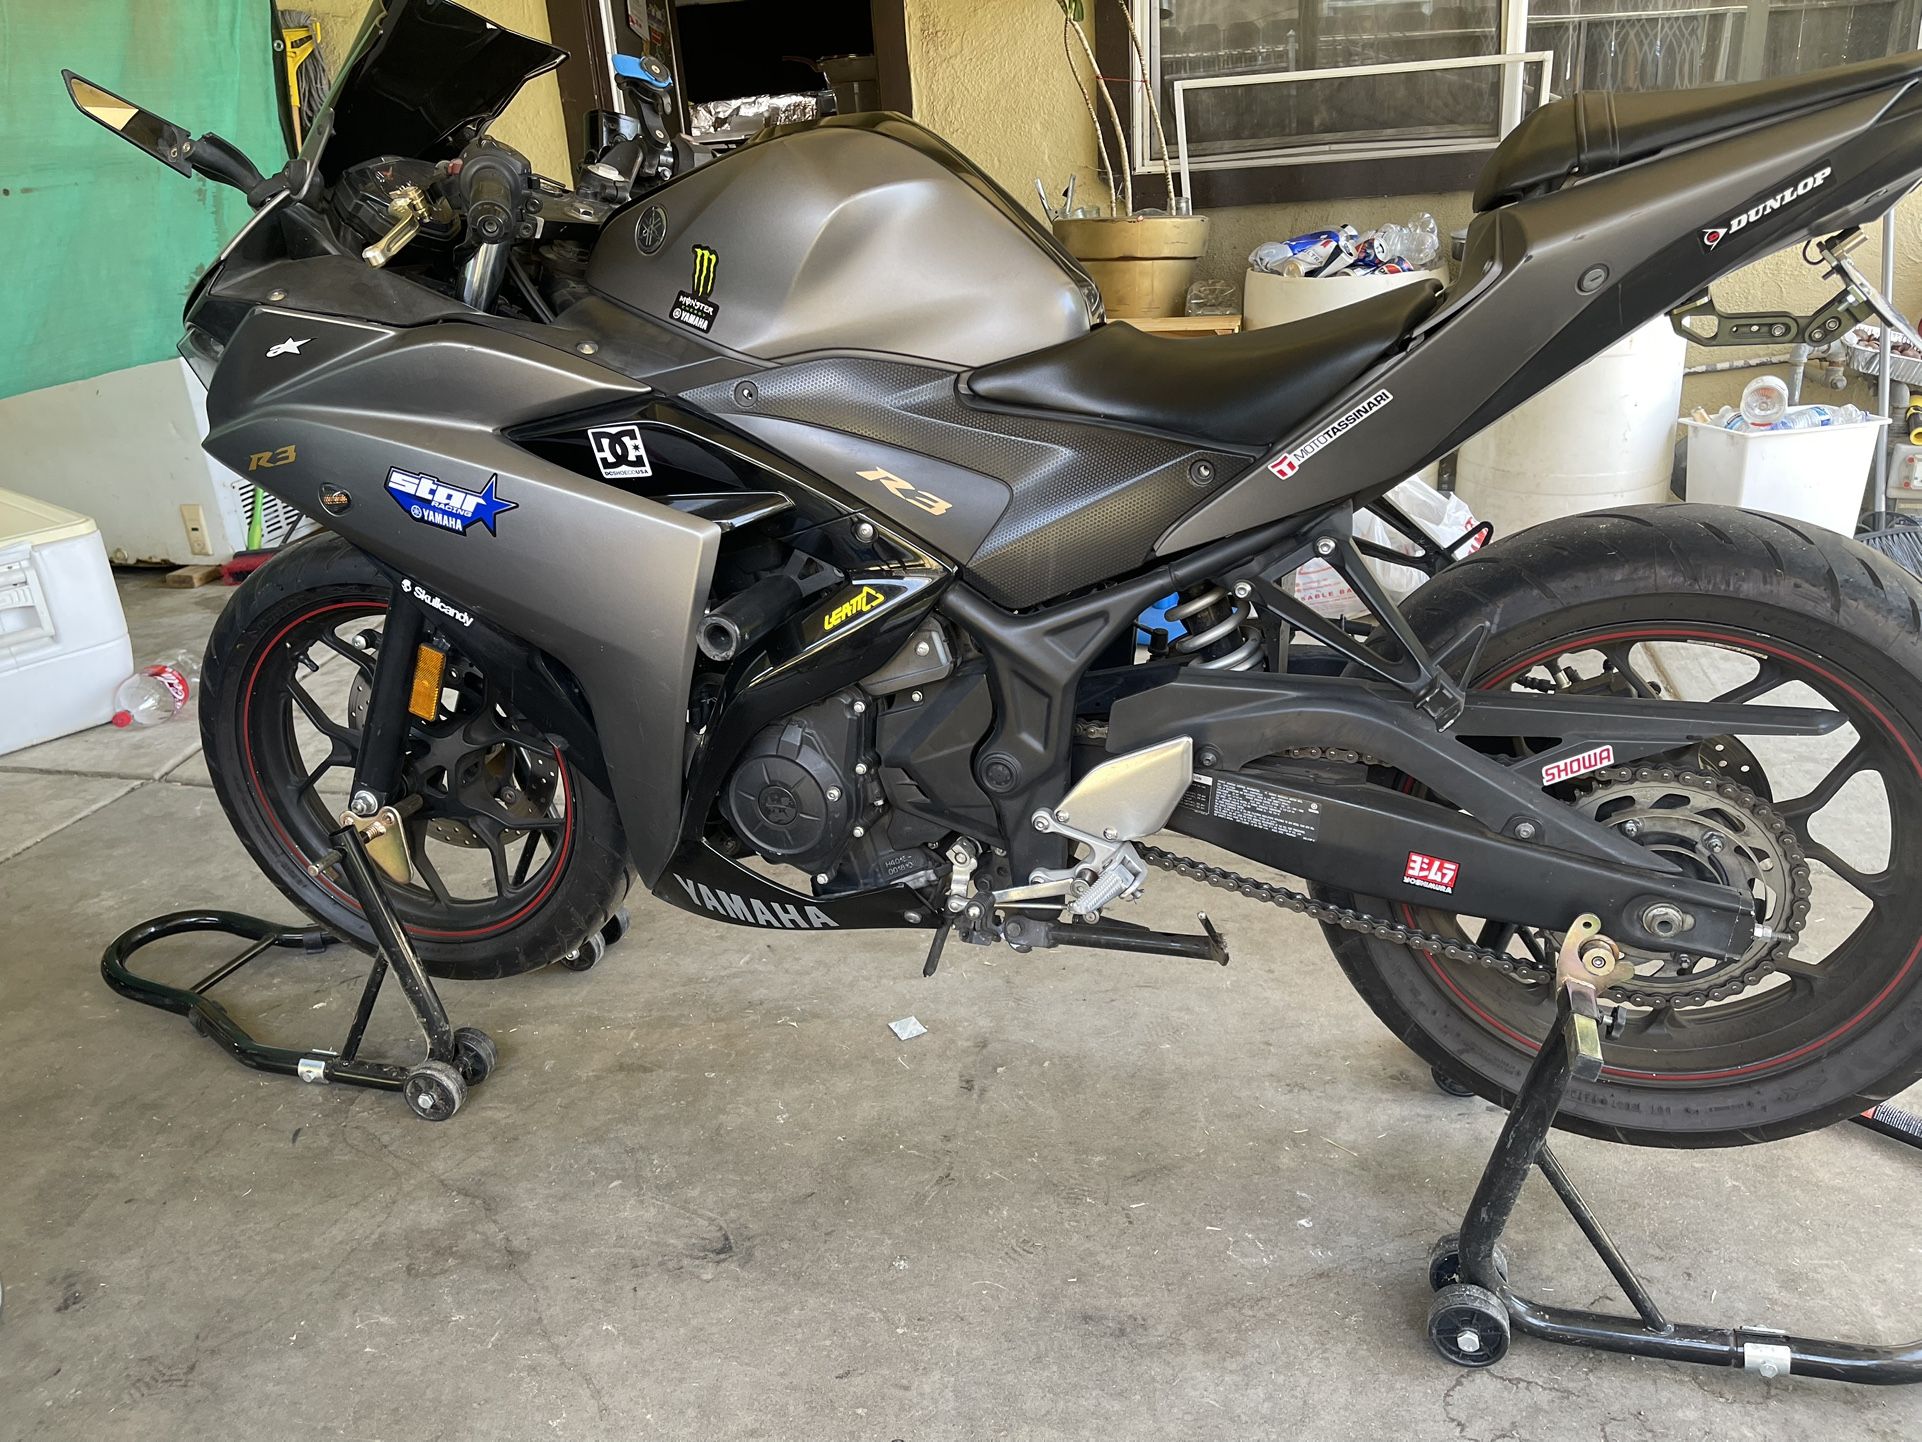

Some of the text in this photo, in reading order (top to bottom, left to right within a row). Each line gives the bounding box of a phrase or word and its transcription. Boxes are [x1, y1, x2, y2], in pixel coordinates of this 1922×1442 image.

[1728, 166, 1832, 234] DUNLOP
[679, 295, 714, 316] MONSTER
[680, 310, 709, 331] YAMAHA
[248, 444, 296, 471] R3
[856, 466, 953, 516] R3
[422, 508, 463, 532] YAMAHA
[431, 500, 473, 518] RACING
[413, 586, 474, 627] Skullcandy
[1545, 748, 1611, 782] SHOWA
[1407, 855, 1456, 884] ヨシムラ
[673, 872, 840, 928] YAMAHA
